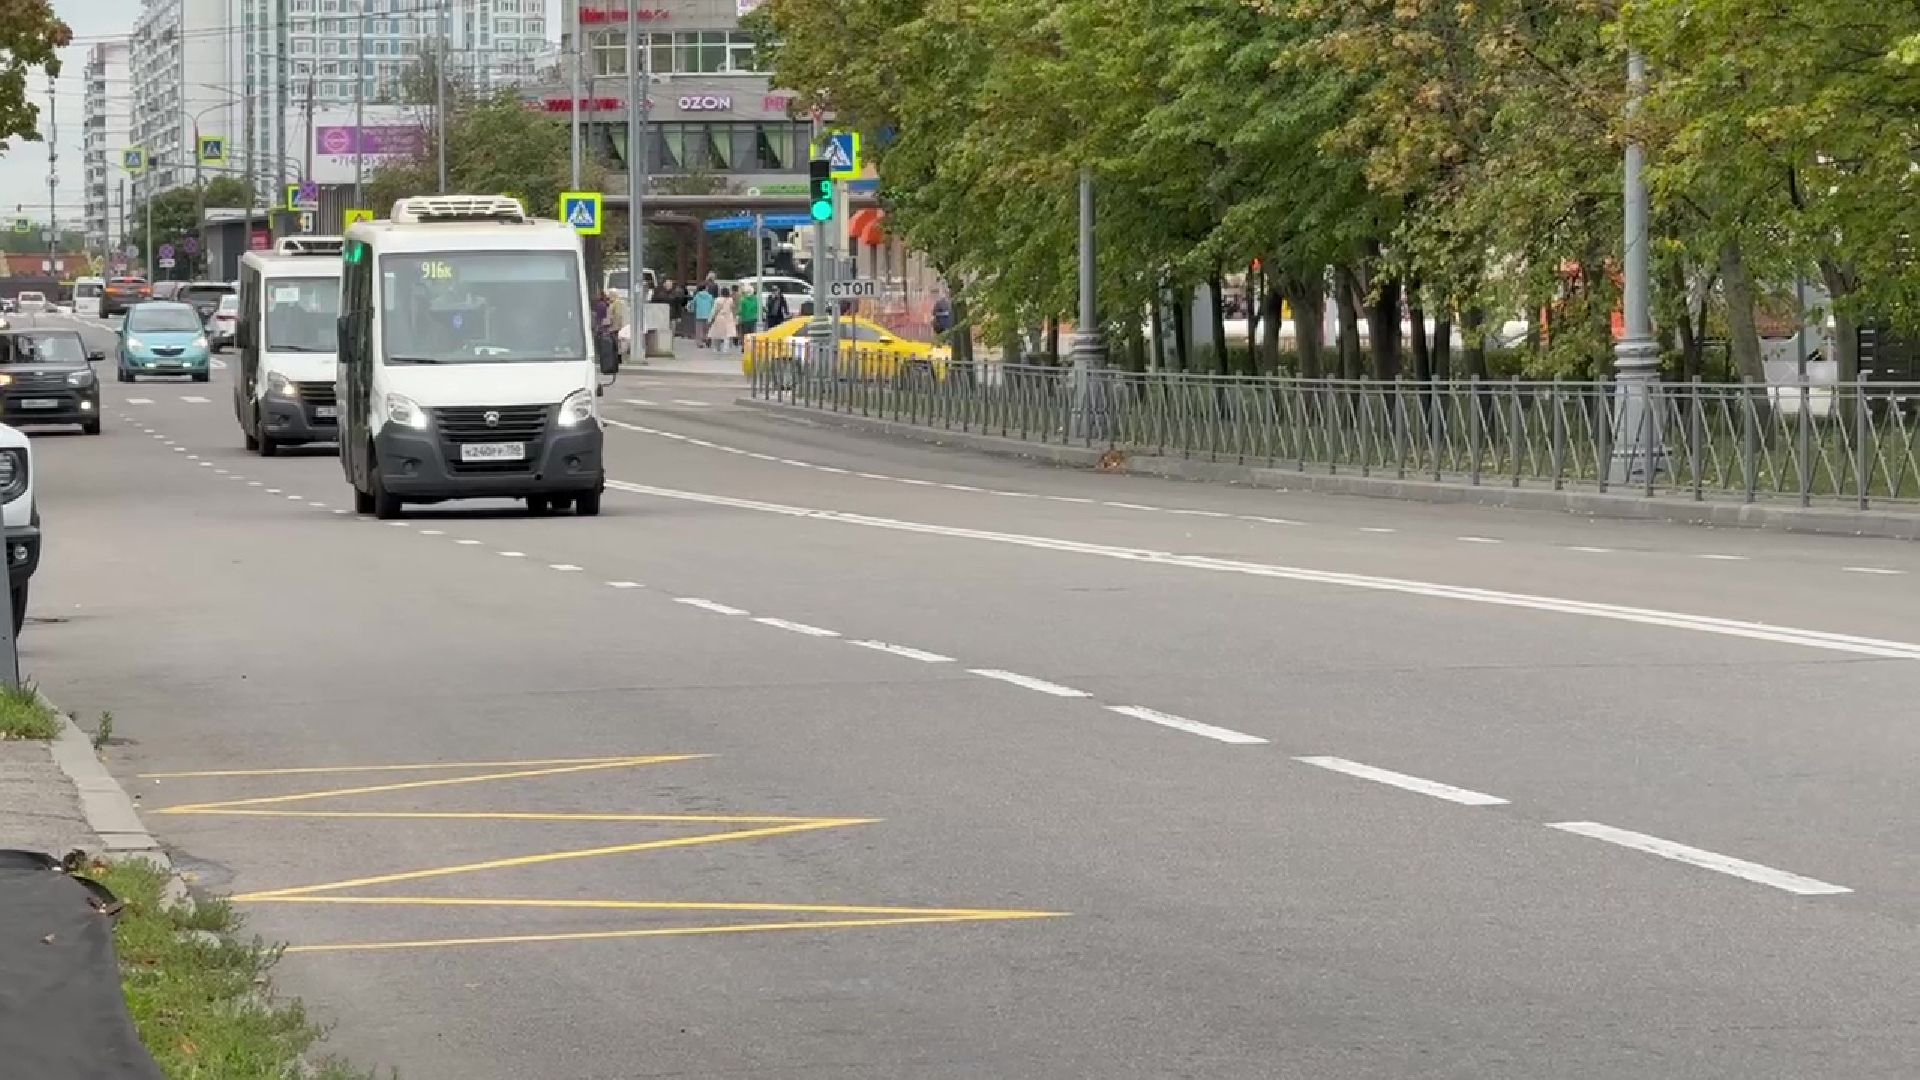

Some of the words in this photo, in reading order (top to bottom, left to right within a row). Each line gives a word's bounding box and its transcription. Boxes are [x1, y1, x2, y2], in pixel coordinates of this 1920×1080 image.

[678, 96, 731, 110] OZON
[821, 180, 832, 199] 9
[831, 282, 874, 295] СТОП
